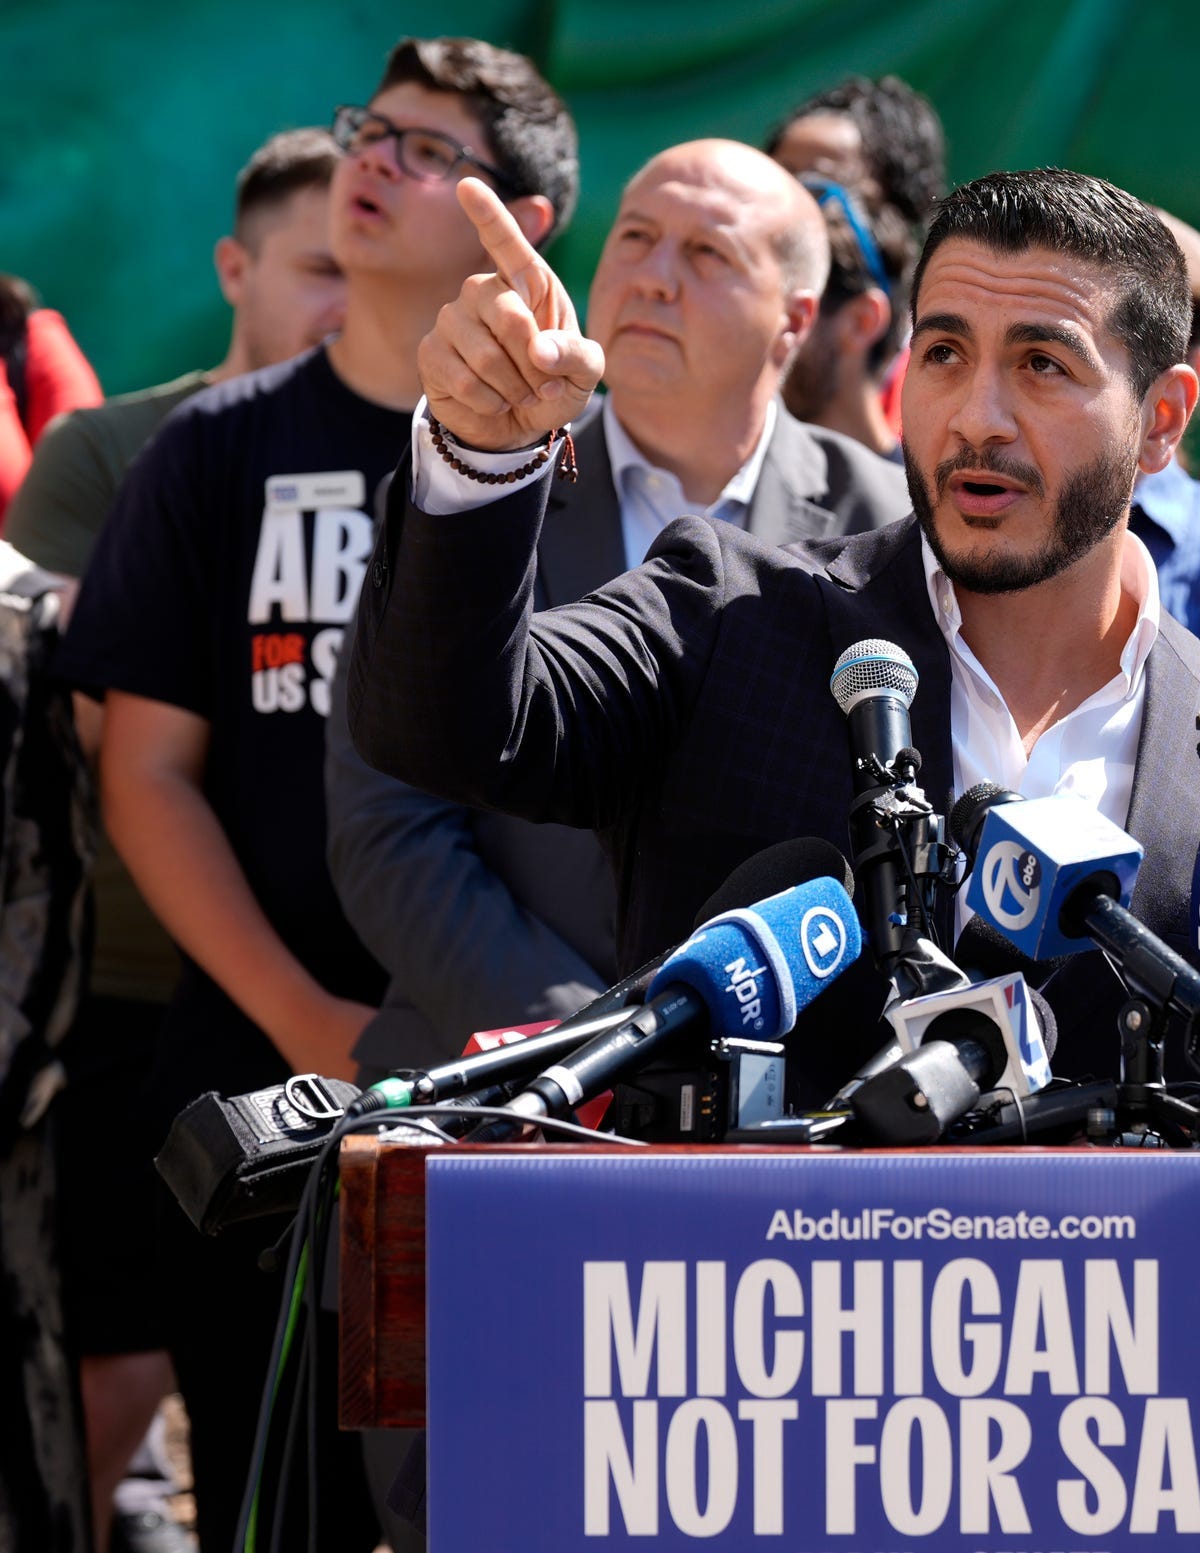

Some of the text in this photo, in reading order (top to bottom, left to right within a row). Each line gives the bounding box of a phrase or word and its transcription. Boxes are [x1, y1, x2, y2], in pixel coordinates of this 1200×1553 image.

[251, 632, 306, 673] FOR
[251, 662, 307, 714] US
[1023, 855, 1037, 886] abc
[725, 957, 763, 1025] NDR
[765, 1208, 1137, 1241] AbdulForSenate.com
[583, 1257, 1159, 1398] MICHIGAN
[583, 1397, 799, 1538] NOT
[825, 1396, 1033, 1536] FOR
